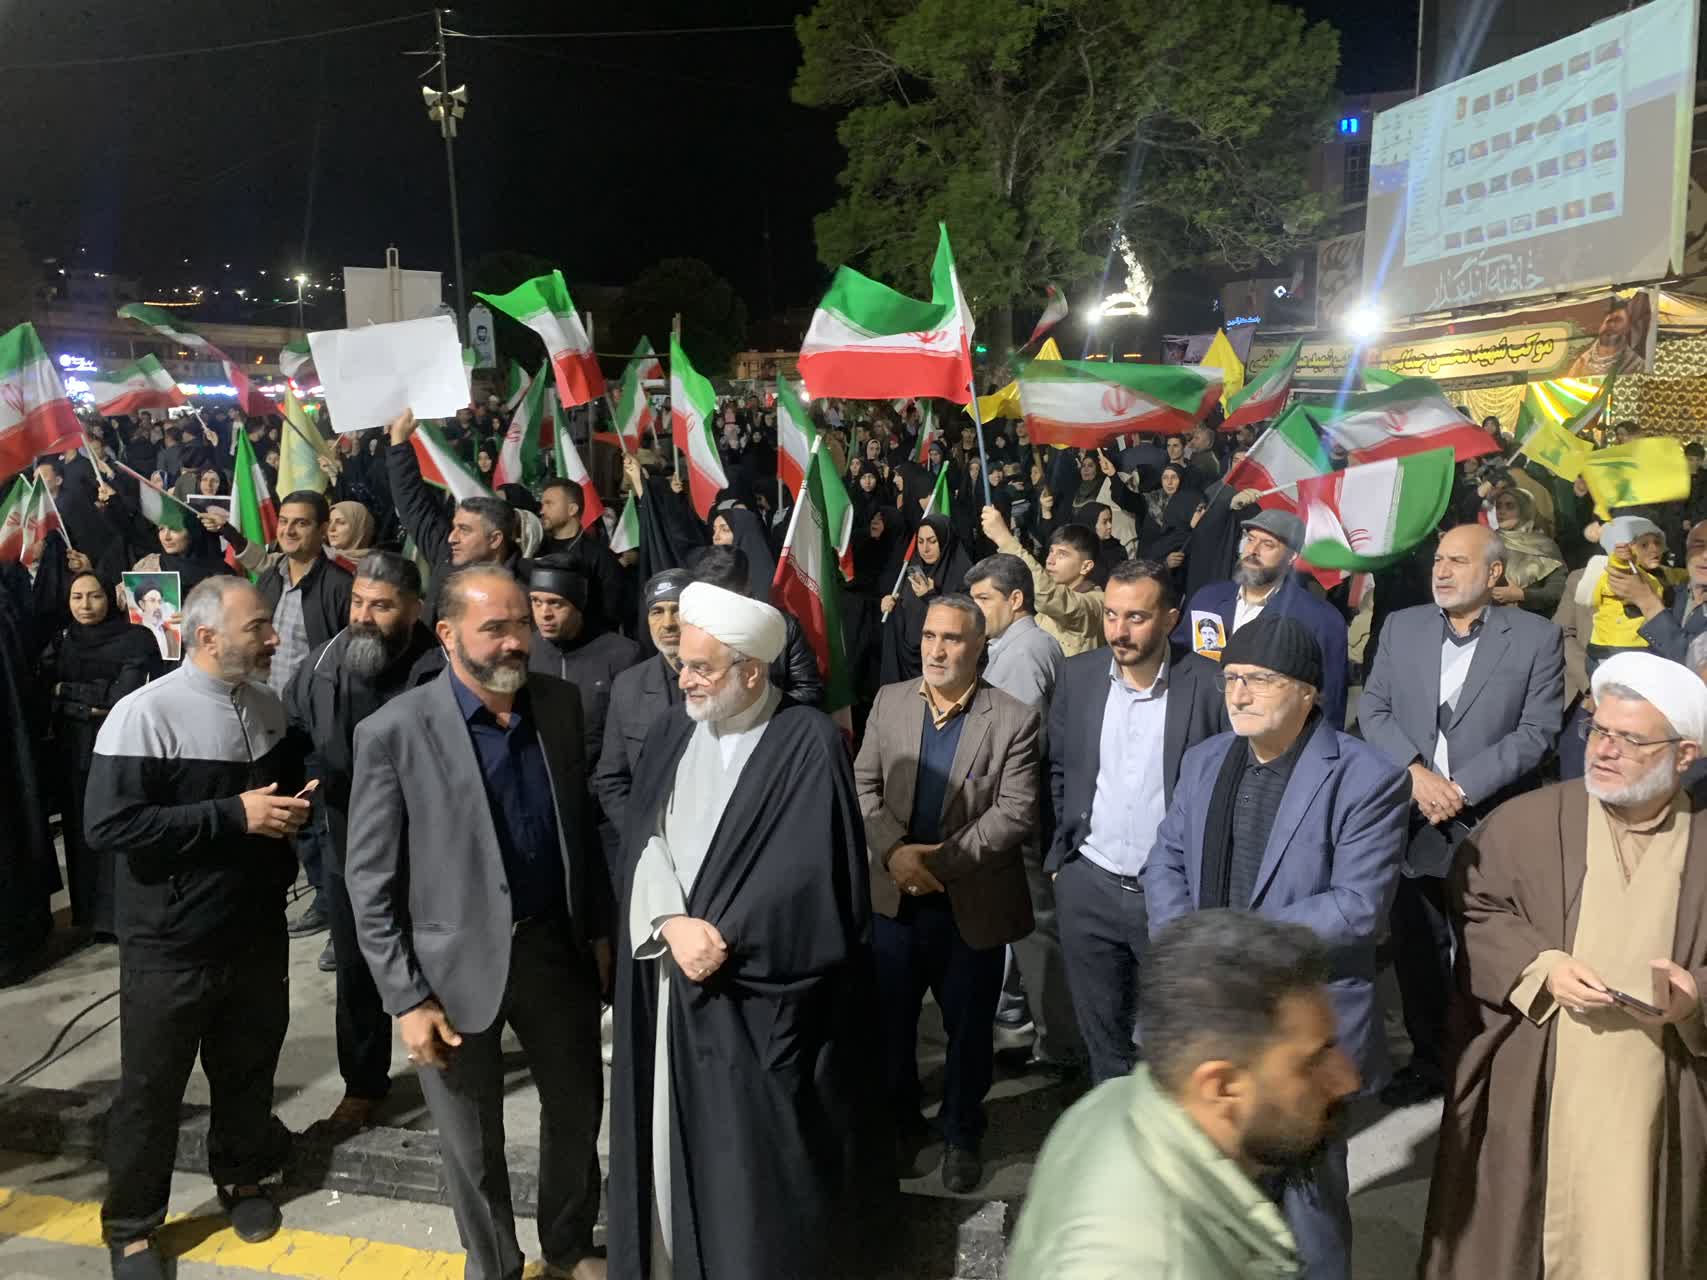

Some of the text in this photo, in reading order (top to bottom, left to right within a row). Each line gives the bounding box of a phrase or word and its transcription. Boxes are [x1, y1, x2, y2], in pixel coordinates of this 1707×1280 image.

[1428, 347, 1471, 374] محسن
[1470, 336, 1508, 367] شهید
[1507, 332, 1554, 364] موکب
